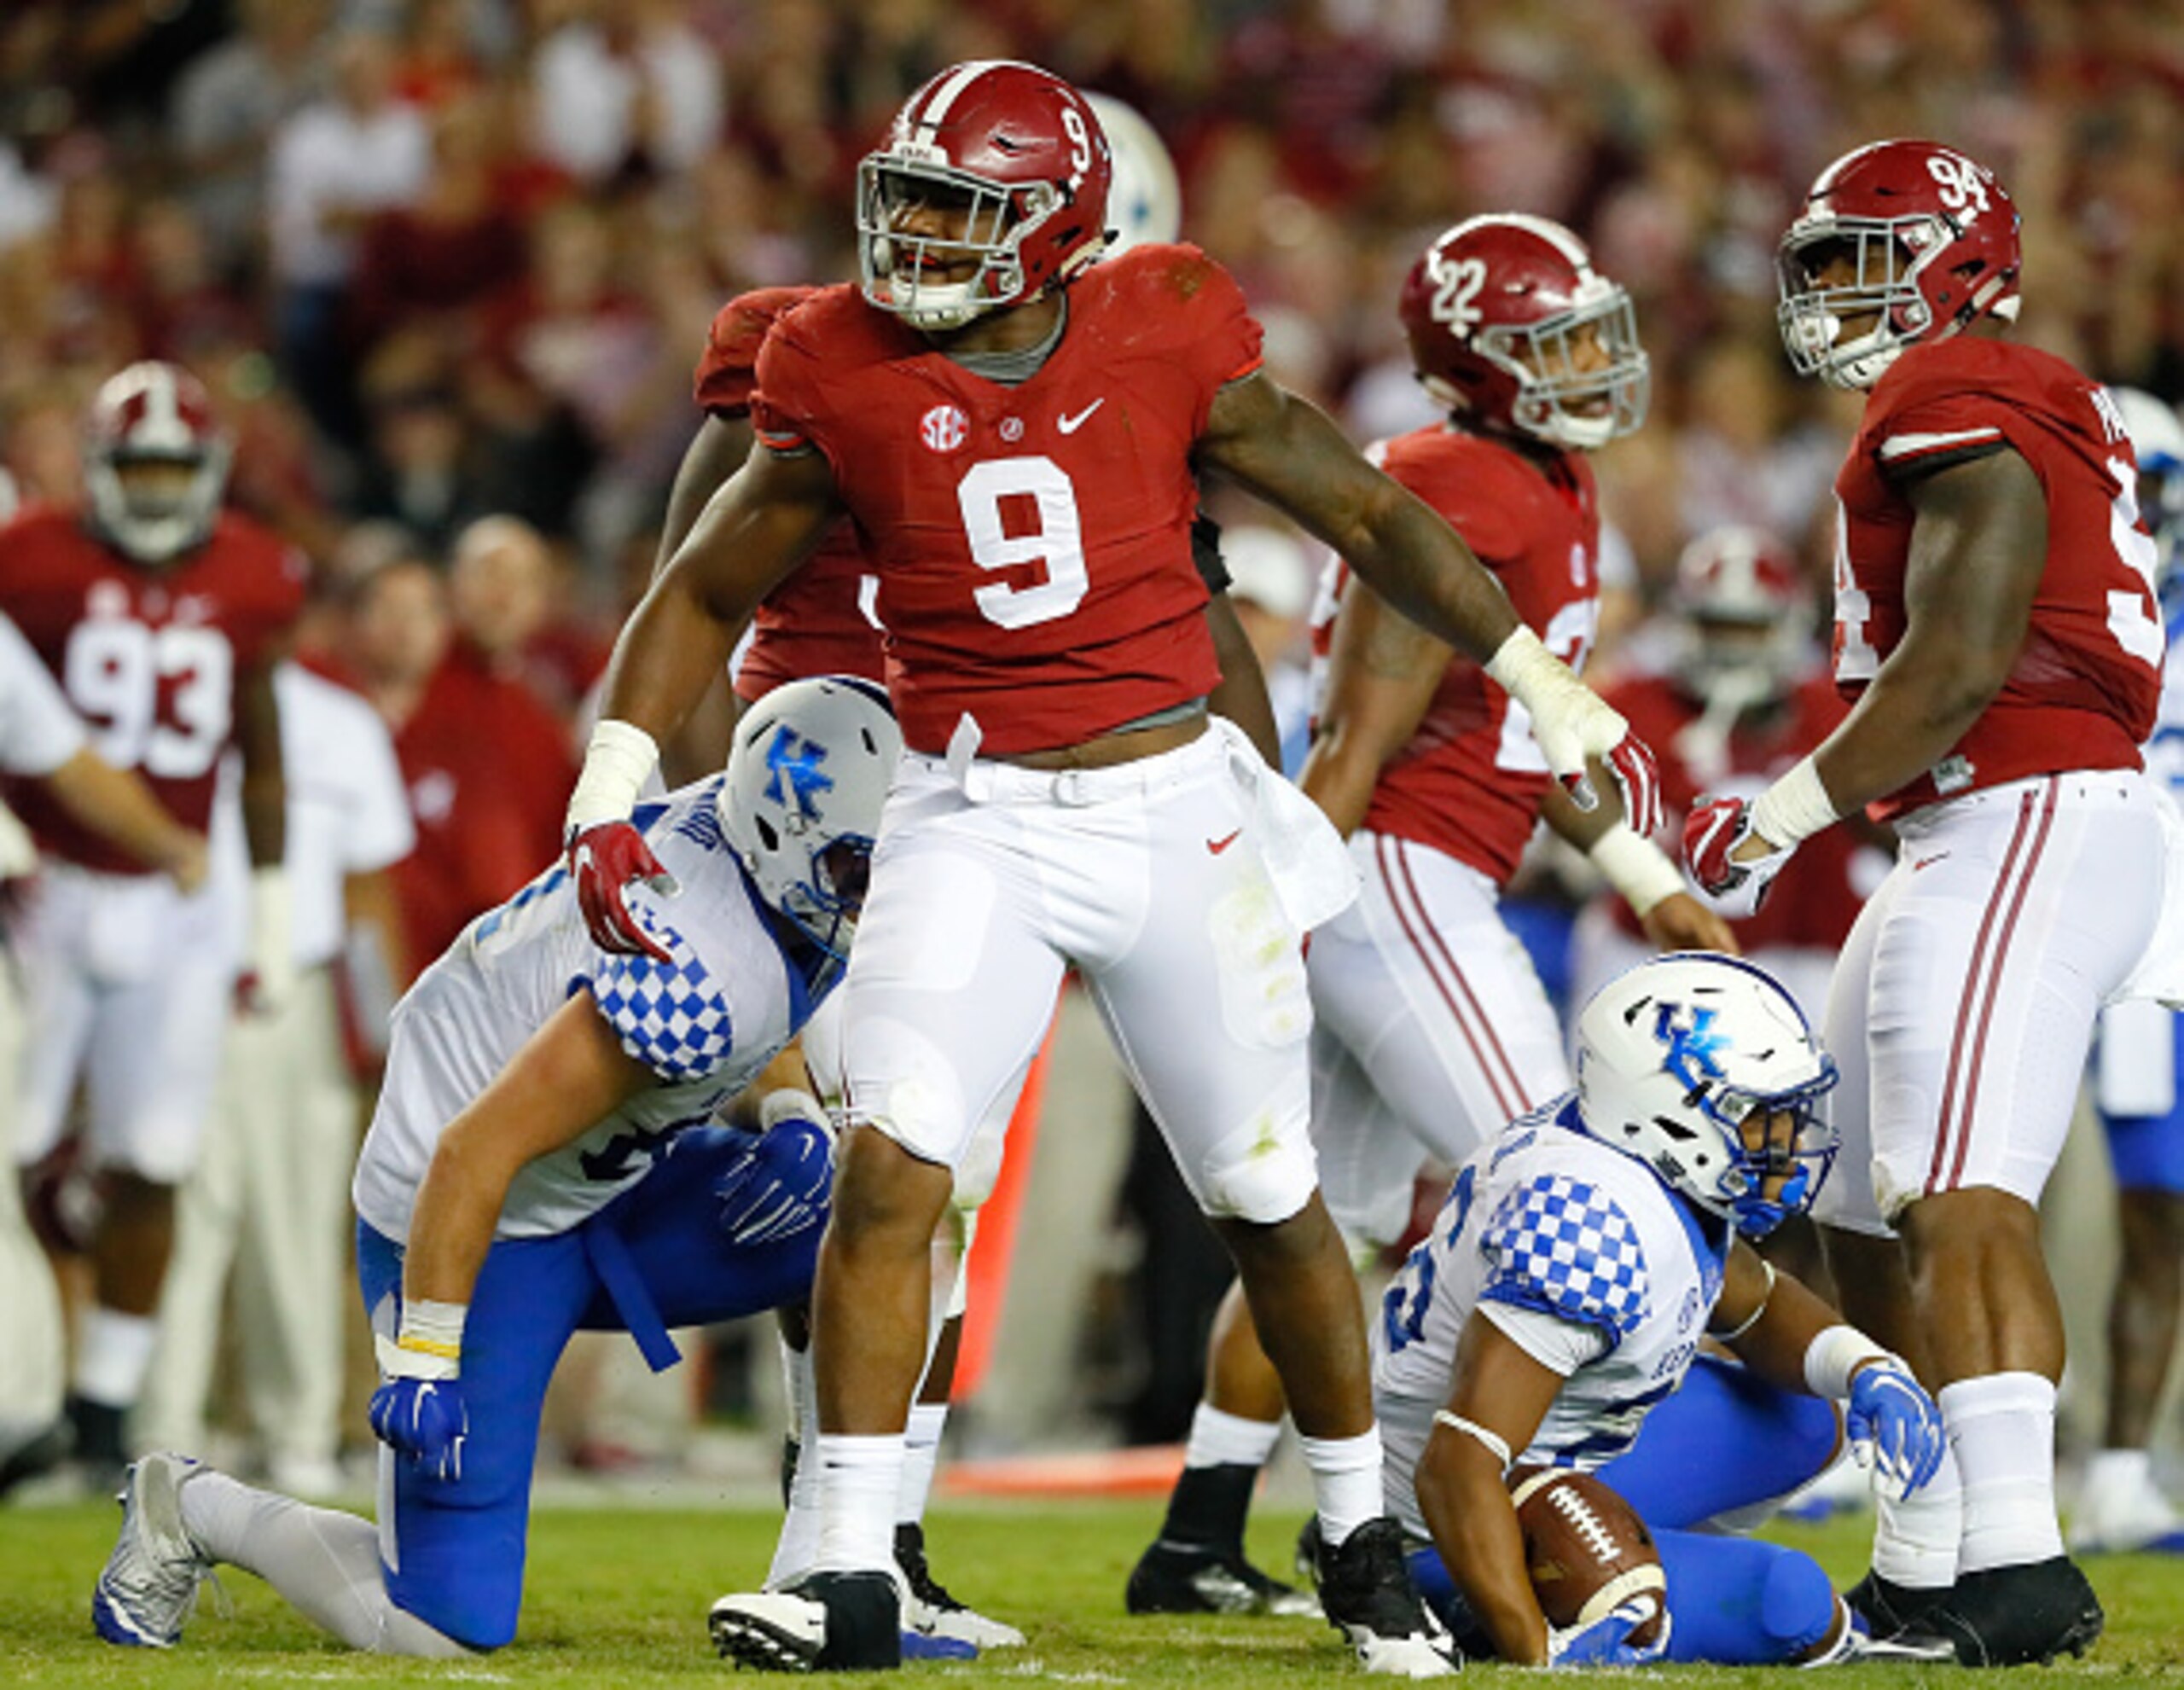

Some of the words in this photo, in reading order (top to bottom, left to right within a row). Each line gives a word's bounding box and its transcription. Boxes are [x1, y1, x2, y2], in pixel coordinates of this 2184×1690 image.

[1060, 107, 1090, 172] 9
[1926, 157, 1991, 212] 94
[1432, 258, 1487, 322] 22
[957, 456, 1089, 630] 9
[64, 620, 234, 777] 93
